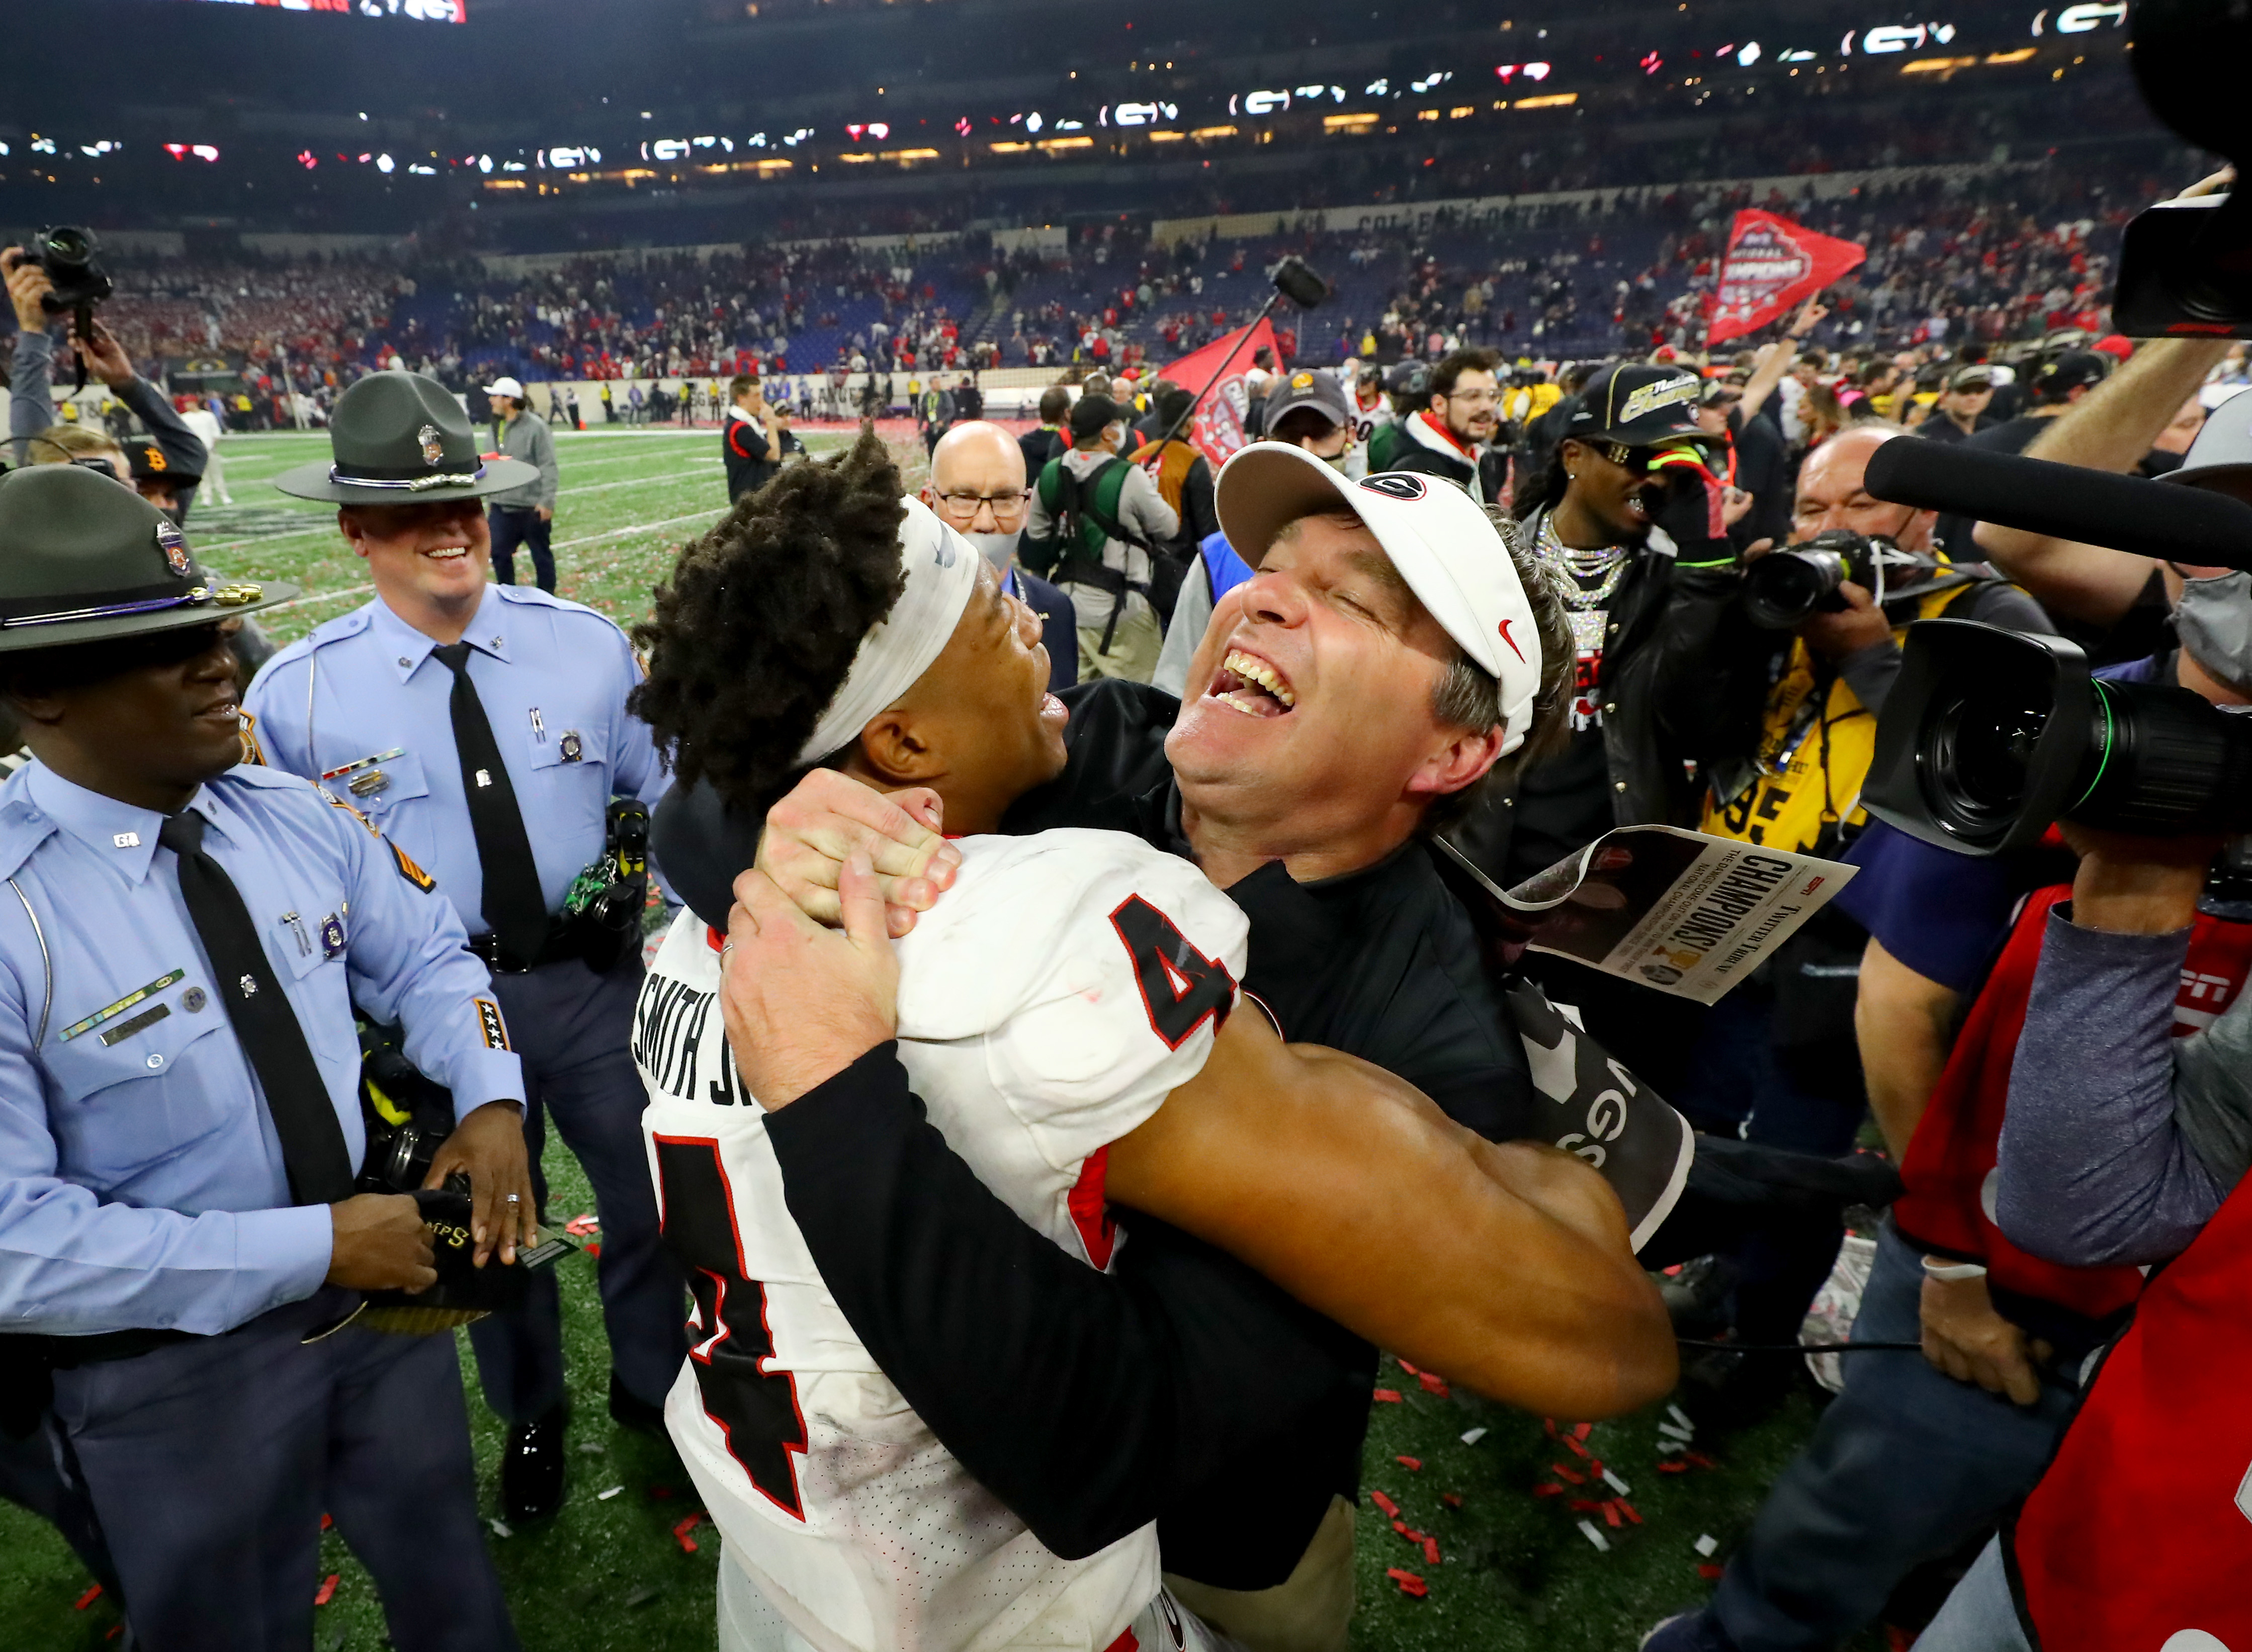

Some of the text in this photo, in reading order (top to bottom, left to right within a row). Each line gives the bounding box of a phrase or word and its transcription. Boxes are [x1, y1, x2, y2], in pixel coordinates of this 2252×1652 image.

[1720, 849, 1742, 862] THE
[1678, 862, 1710, 891] NATIONAL
[1669, 854, 1793, 952] CHAMPIONS!
[1674, 900, 1692, 913] OUT
[1685, 883, 1709, 901] COME
[1108, 892, 1239, 1053] 4
[631, 972, 716, 1100] SMITH
